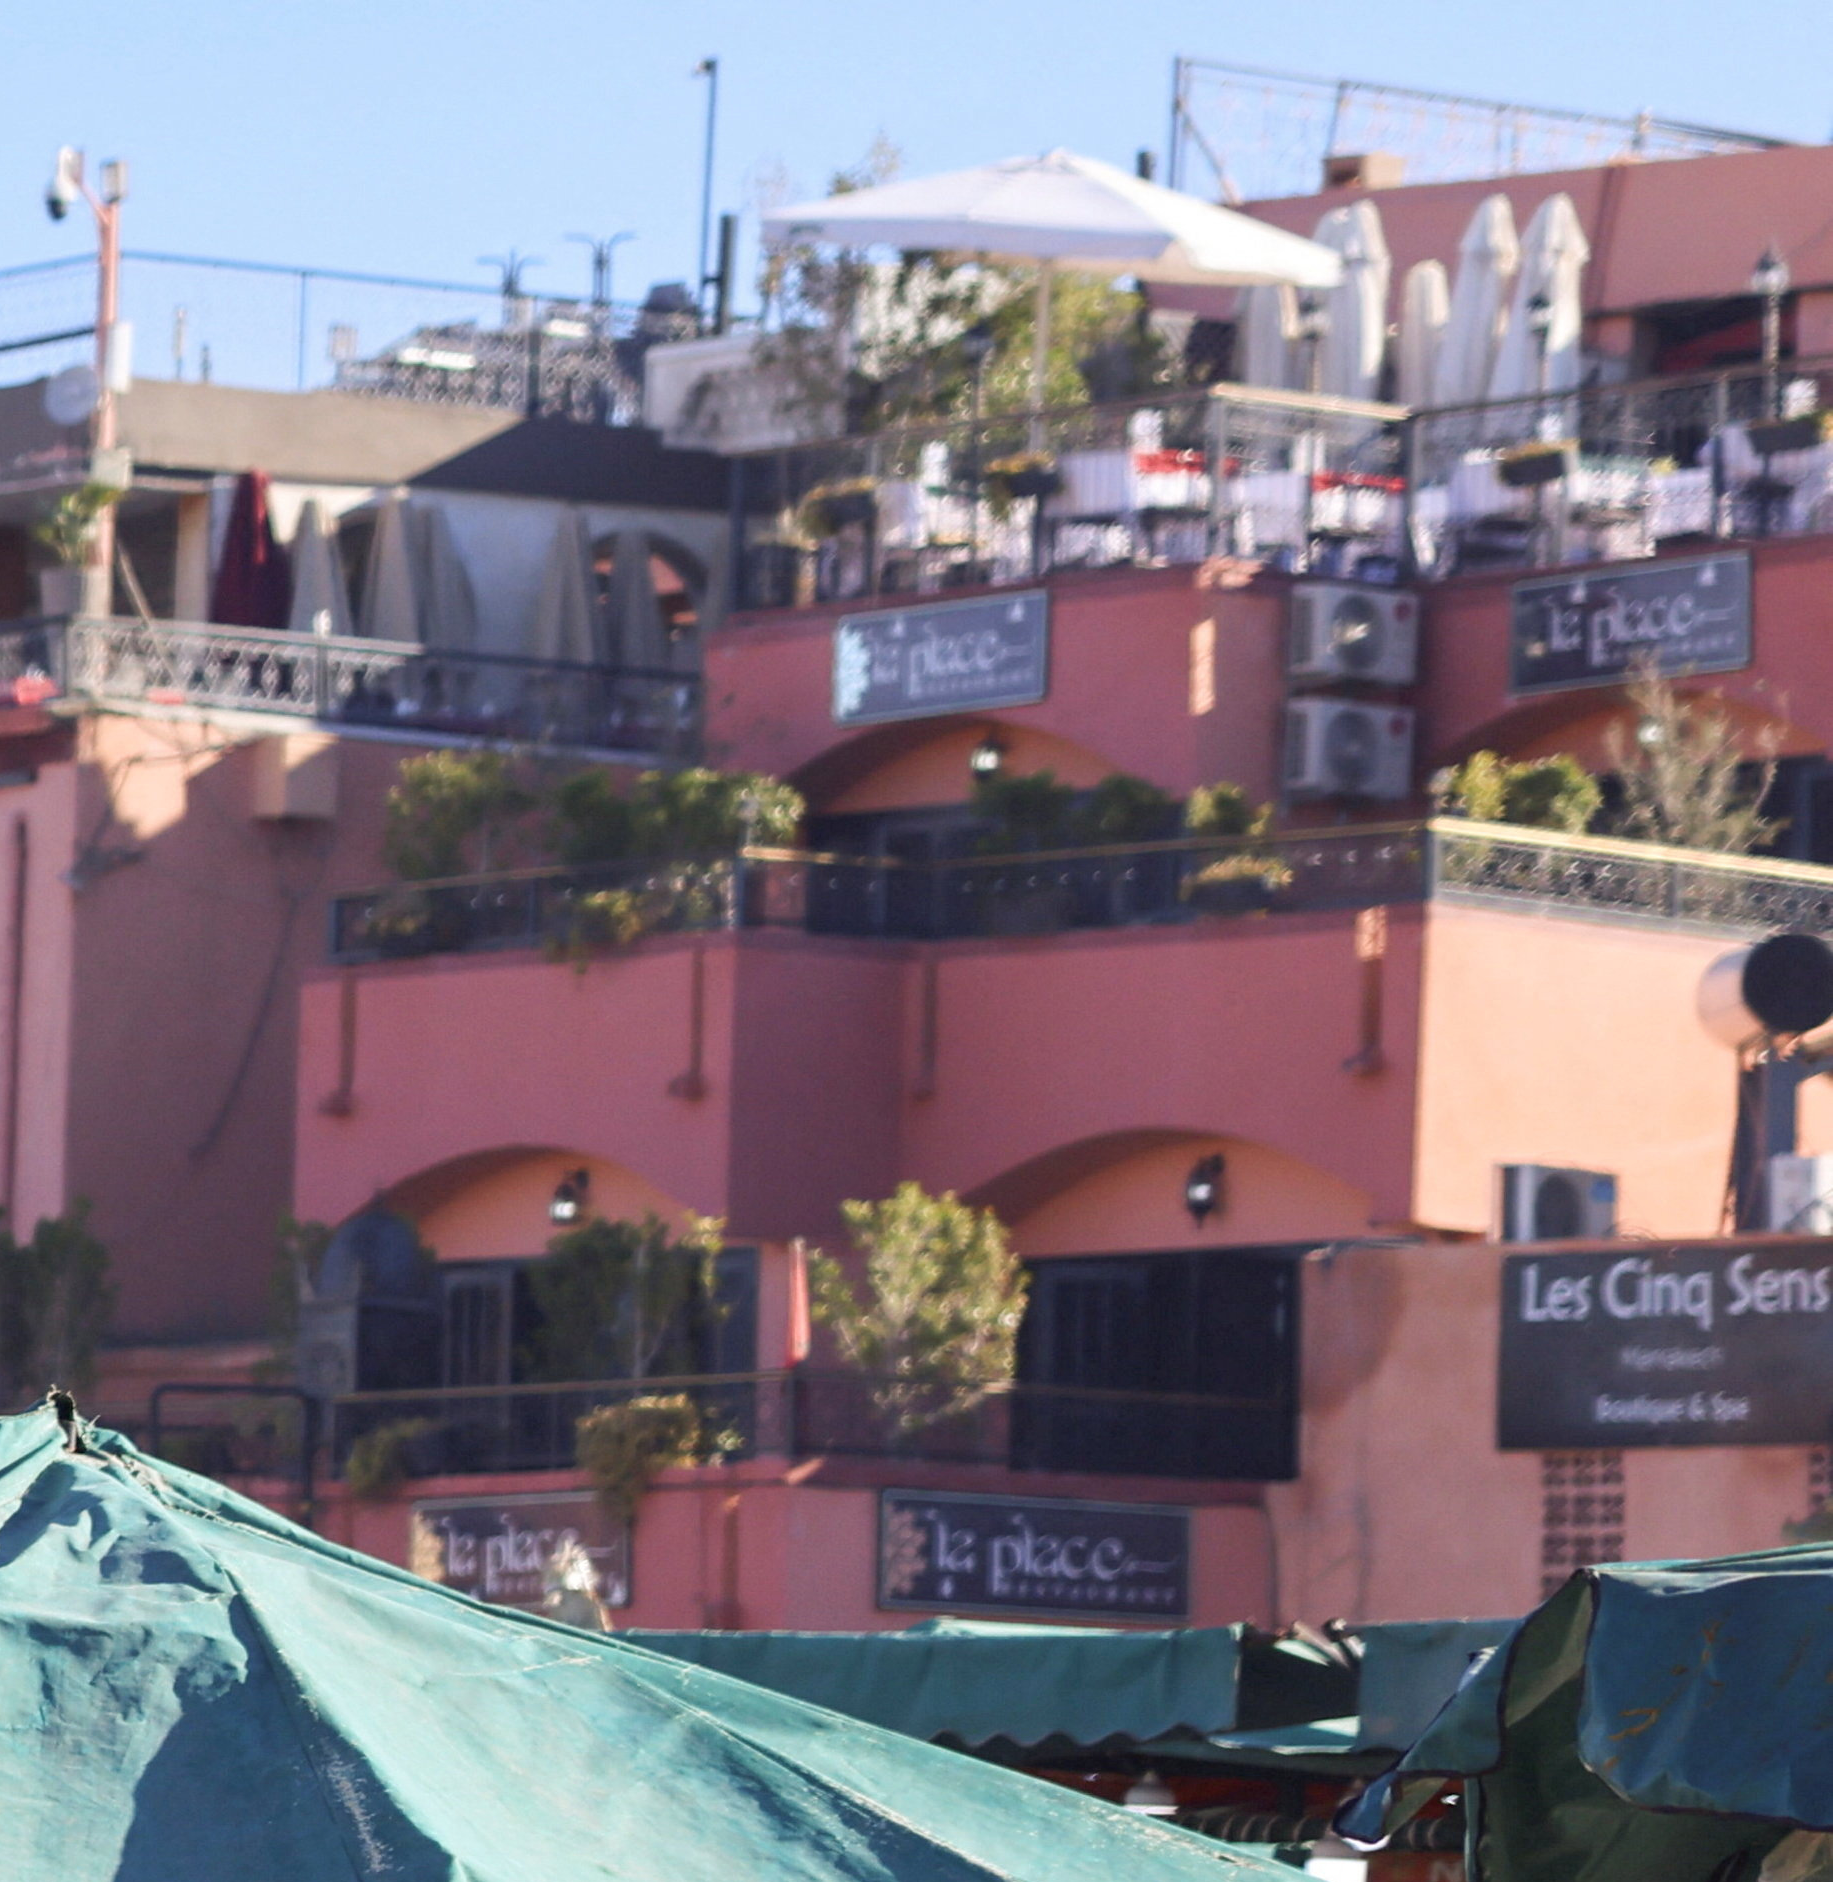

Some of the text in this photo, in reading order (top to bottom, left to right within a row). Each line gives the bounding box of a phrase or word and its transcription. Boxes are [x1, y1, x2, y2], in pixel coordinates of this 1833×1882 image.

[1522, 1253, 1833, 1332] Les Cinq Sens
[926, 1508, 1148, 1597] la place
